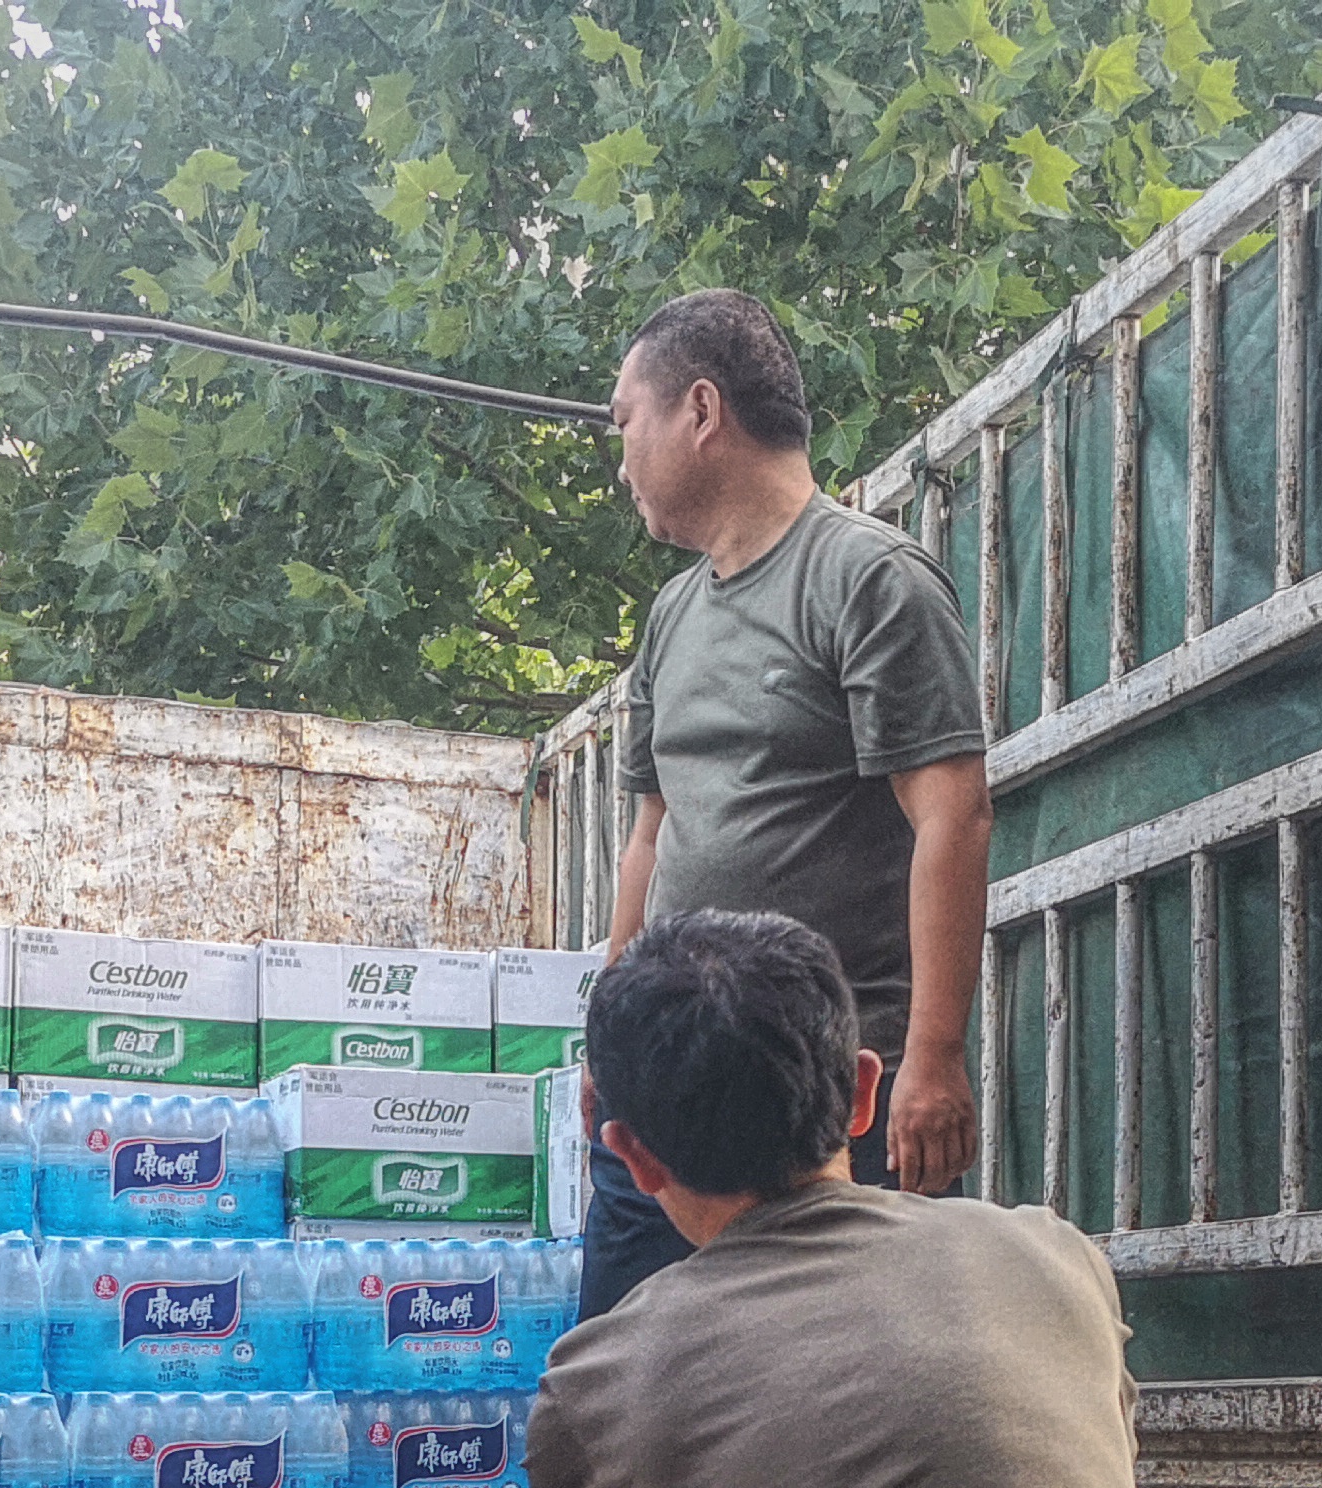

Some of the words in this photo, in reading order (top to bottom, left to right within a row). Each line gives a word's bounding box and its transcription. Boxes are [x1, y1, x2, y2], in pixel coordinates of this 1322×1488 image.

[346, 961, 419, 996] 怡寶
[87, 986, 121, 998] Purified
[121, 988, 154, 1002] Drinking
[156, 991, 182, 1002] Water
[346, 998, 411, 1010] 饮用纯净水
[371, 1124, 404, 1135] Purified
[405, 1126, 437, 1138] Drinking
[439, 1127, 465, 1137] Water
[417, 1433, 483, 1473] 康師傅
